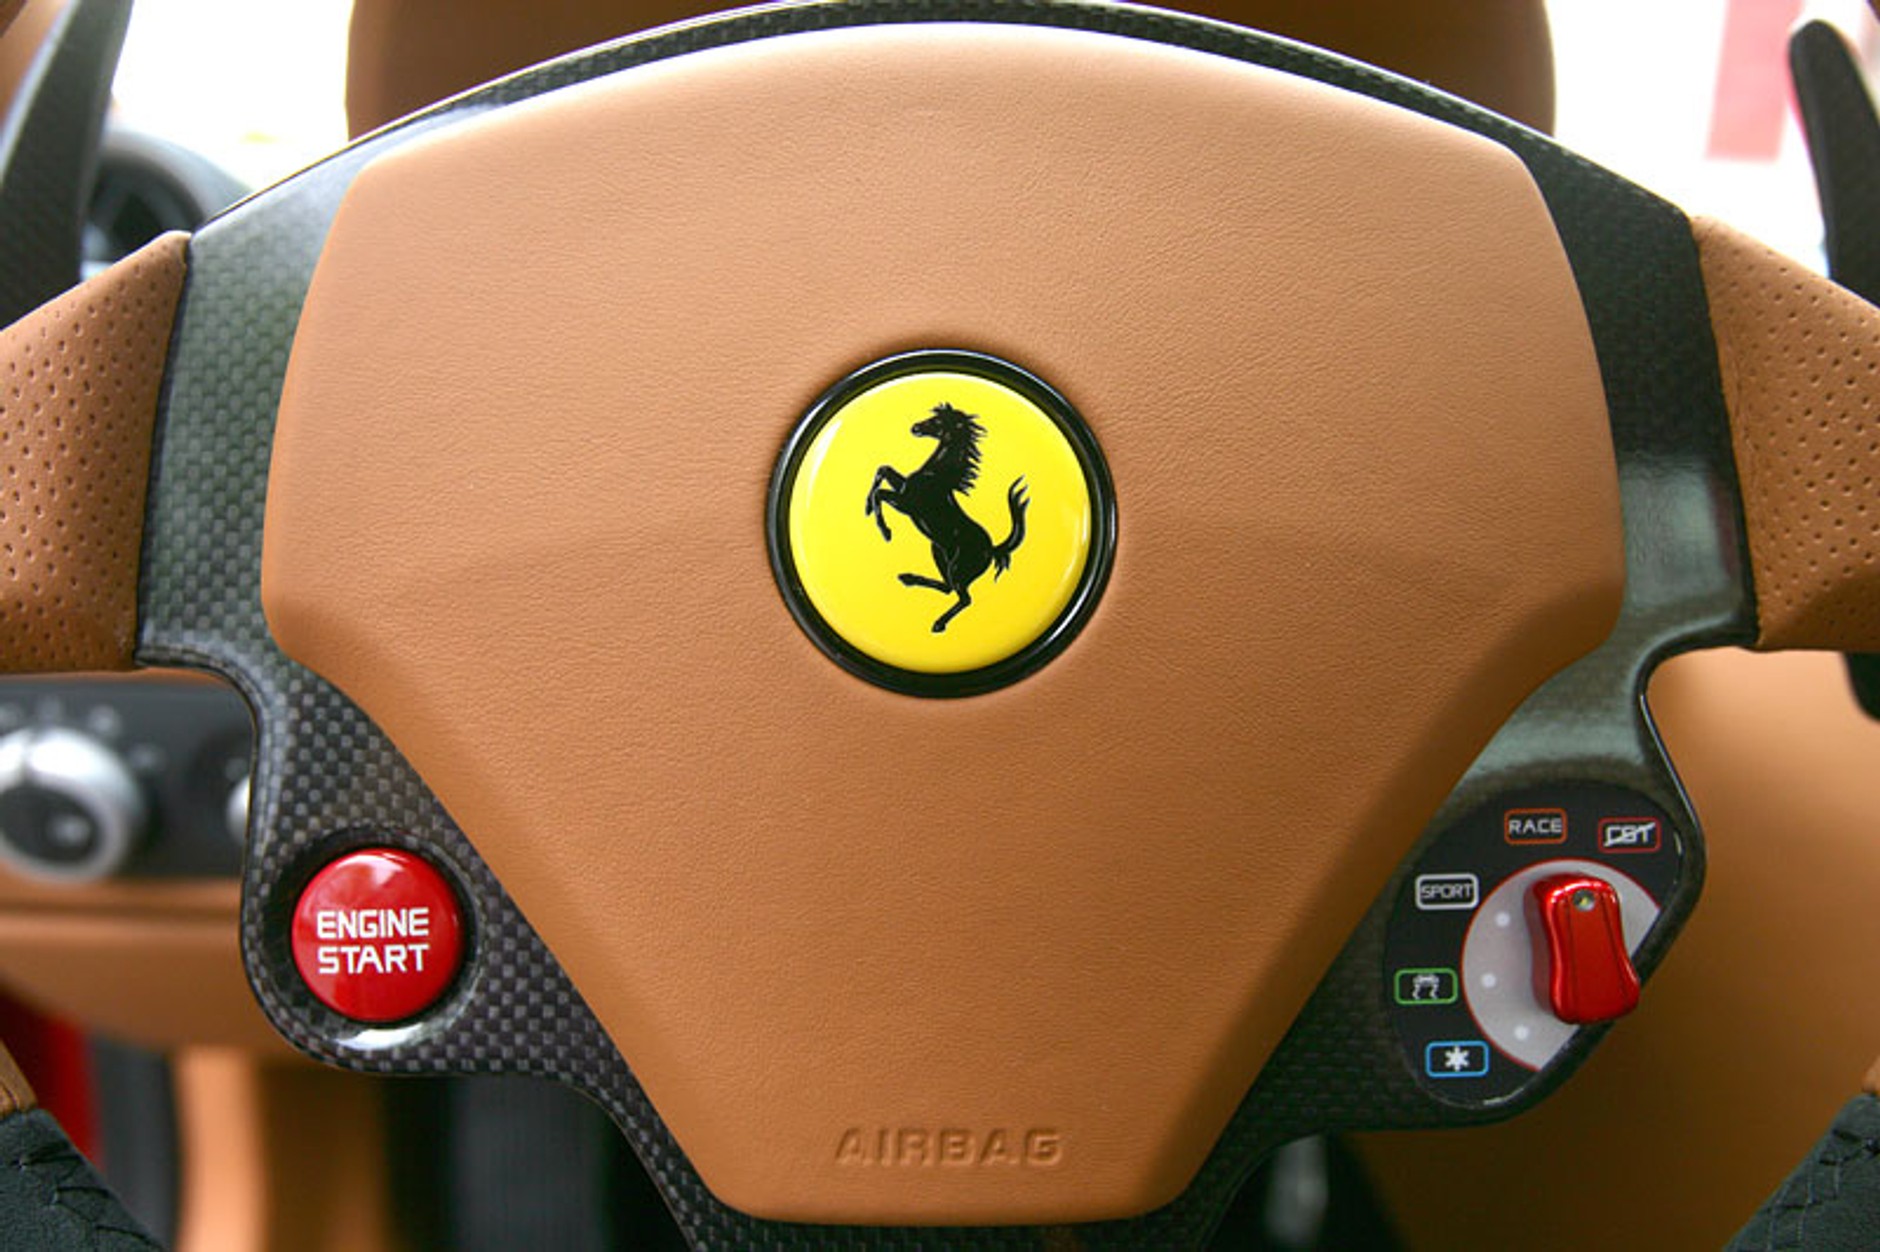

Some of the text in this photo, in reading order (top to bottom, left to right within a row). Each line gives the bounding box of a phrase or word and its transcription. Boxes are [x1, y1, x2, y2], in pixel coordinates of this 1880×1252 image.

[1508, 818, 1562, 834] RACE
[1420, 883, 1473, 899] SPORT
[316, 907, 430, 940] ENGINE
[317, 943, 430, 974] START
[834, 1126, 1064, 1167] AIRBAG
